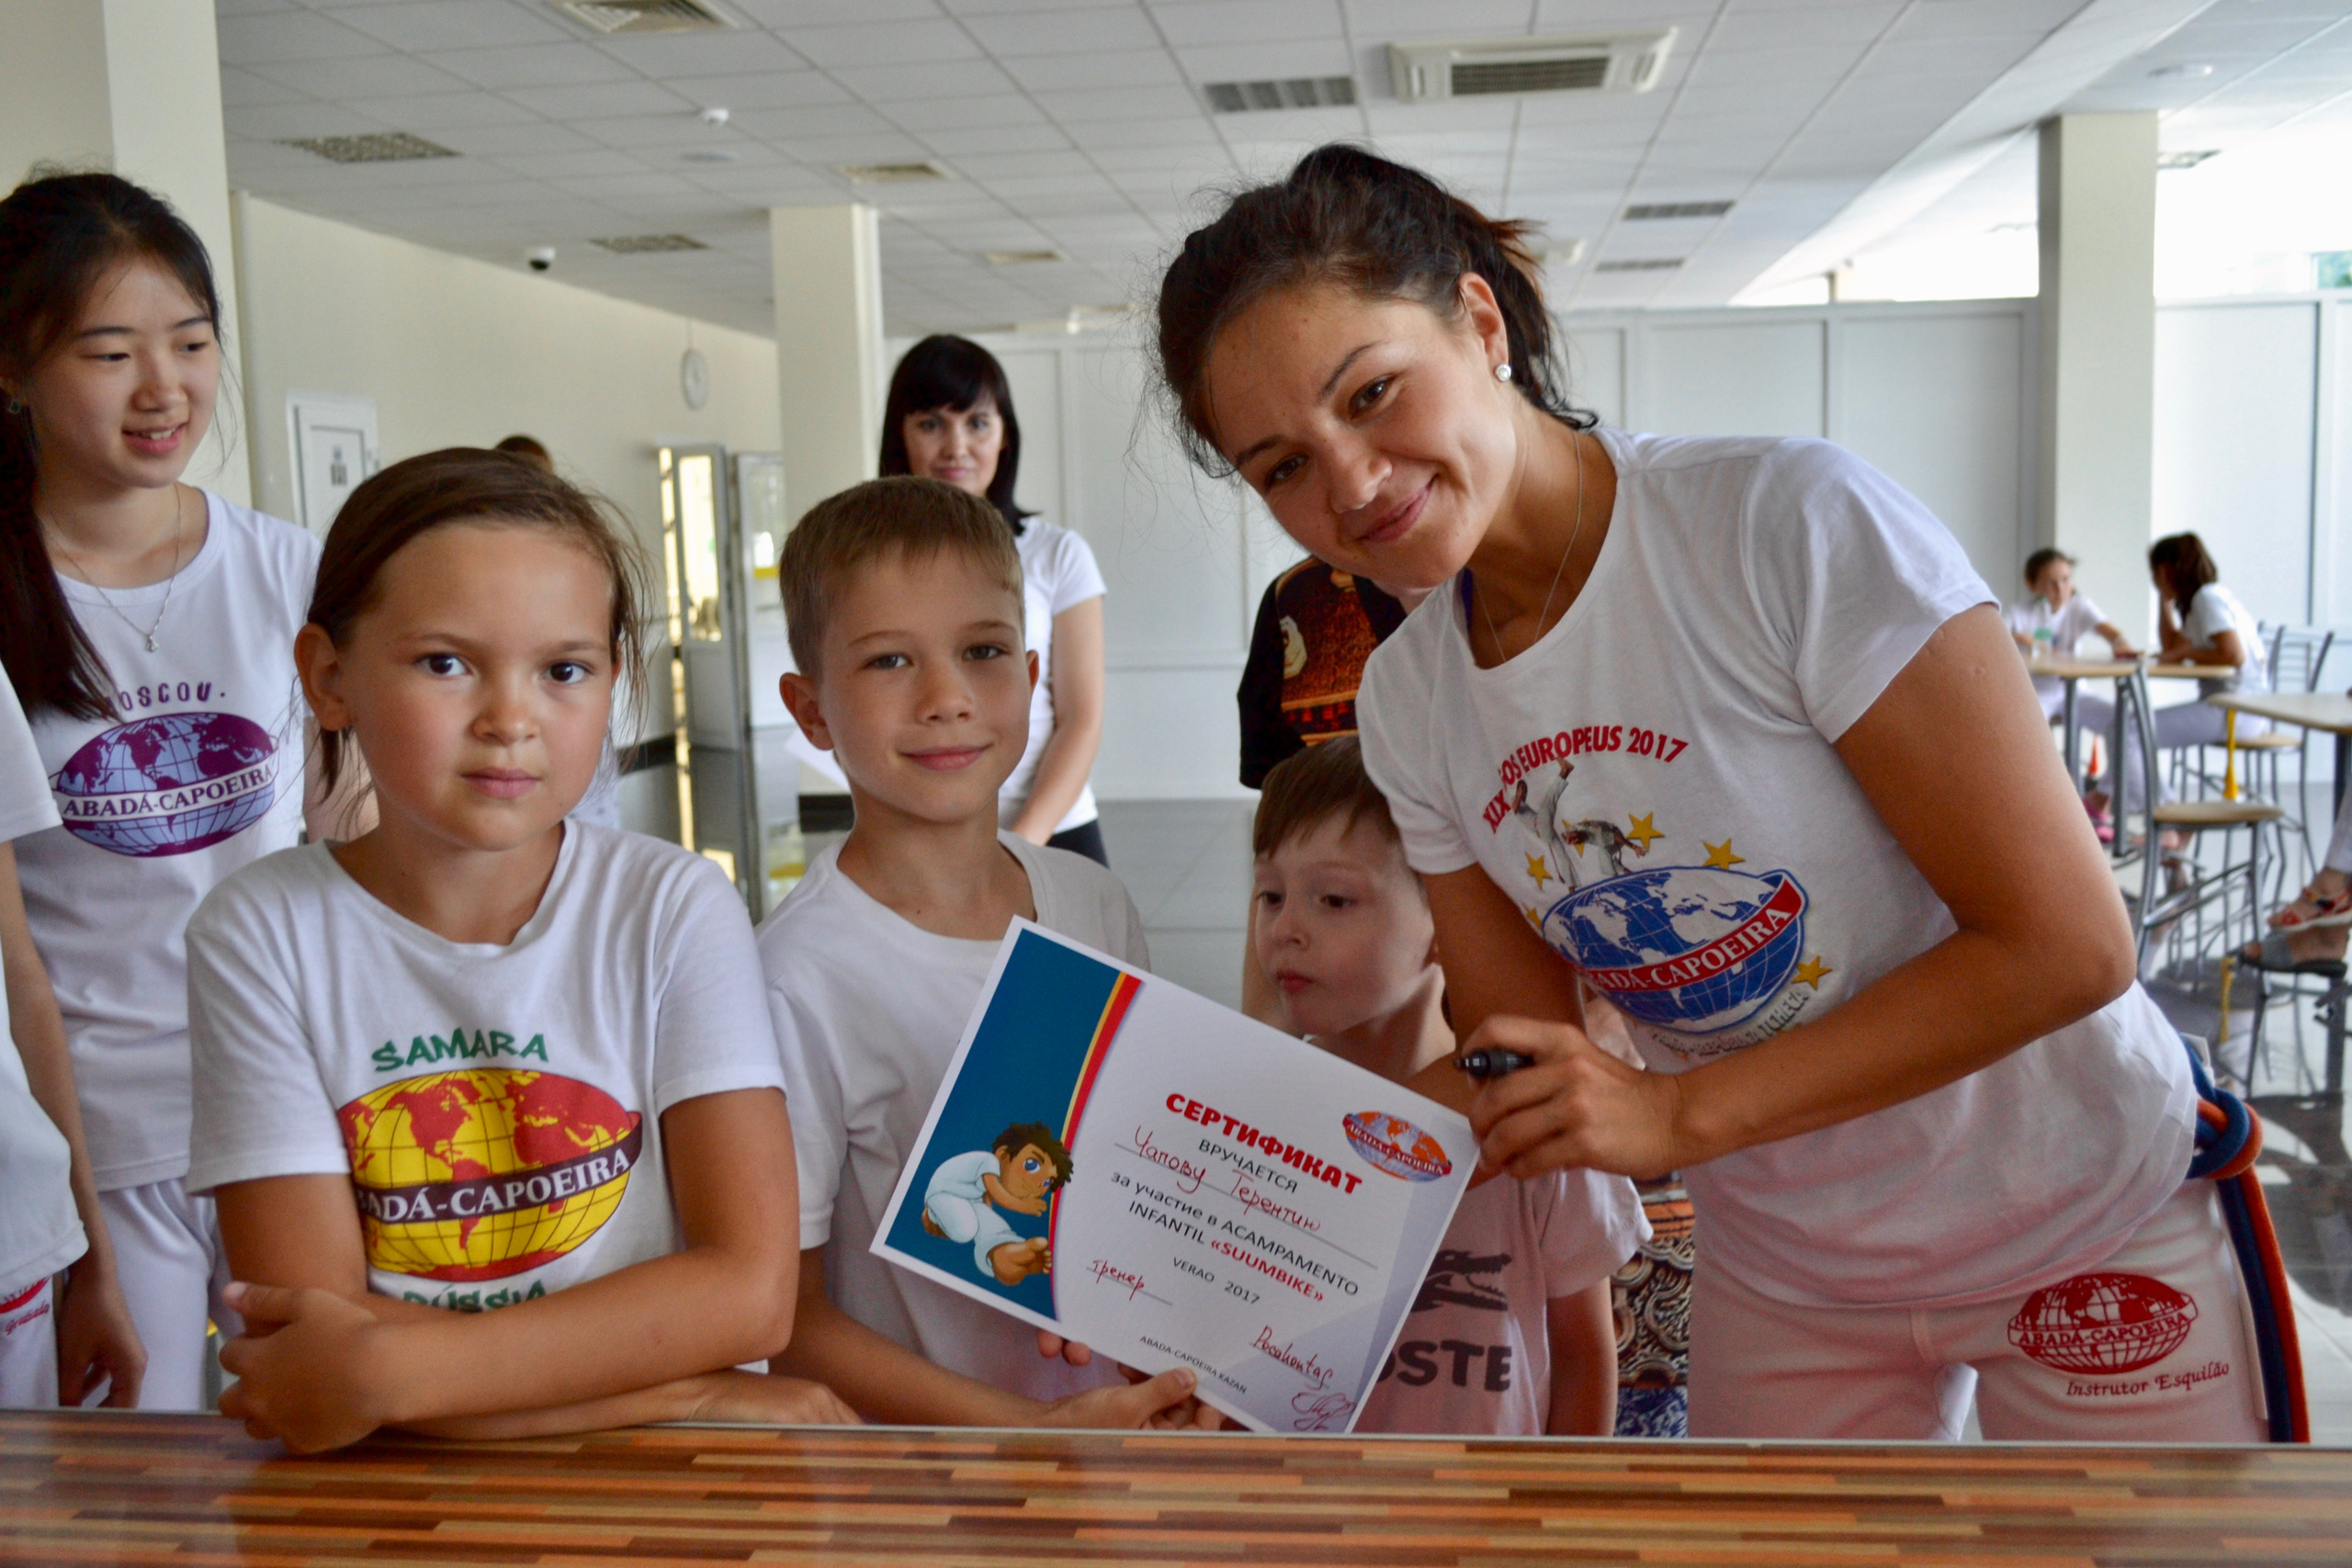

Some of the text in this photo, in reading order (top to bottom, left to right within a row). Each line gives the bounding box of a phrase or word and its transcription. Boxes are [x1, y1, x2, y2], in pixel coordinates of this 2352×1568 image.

[1516, 725, 1623, 773] EUROPEUS
[1625, 727, 1689, 763] 2017
[62, 764, 273, 818] ABADÁ-CAPOEIRA
[371, 1027, 549, 1072] SAMARA
[1164, 1092, 1363, 1195] СЕРТИФИКАТ
[1198, 1138, 1298, 1194] ВРУЧАЕТСЯ
[1111, 1171, 1131, 1188] за
[1135, 1179, 1204, 1221] участие
[1206, 1213, 1217, 1226] в
[1128, 1200, 1324, 1303] INFANTIL «SUUMBIKE»
[1172, 1257, 1261, 1305] VERAO 2017
[1218, 1371, 1248, 1394] KAZAN
[2066, 1359, 2230, 1397] Instrutor Esquilão
